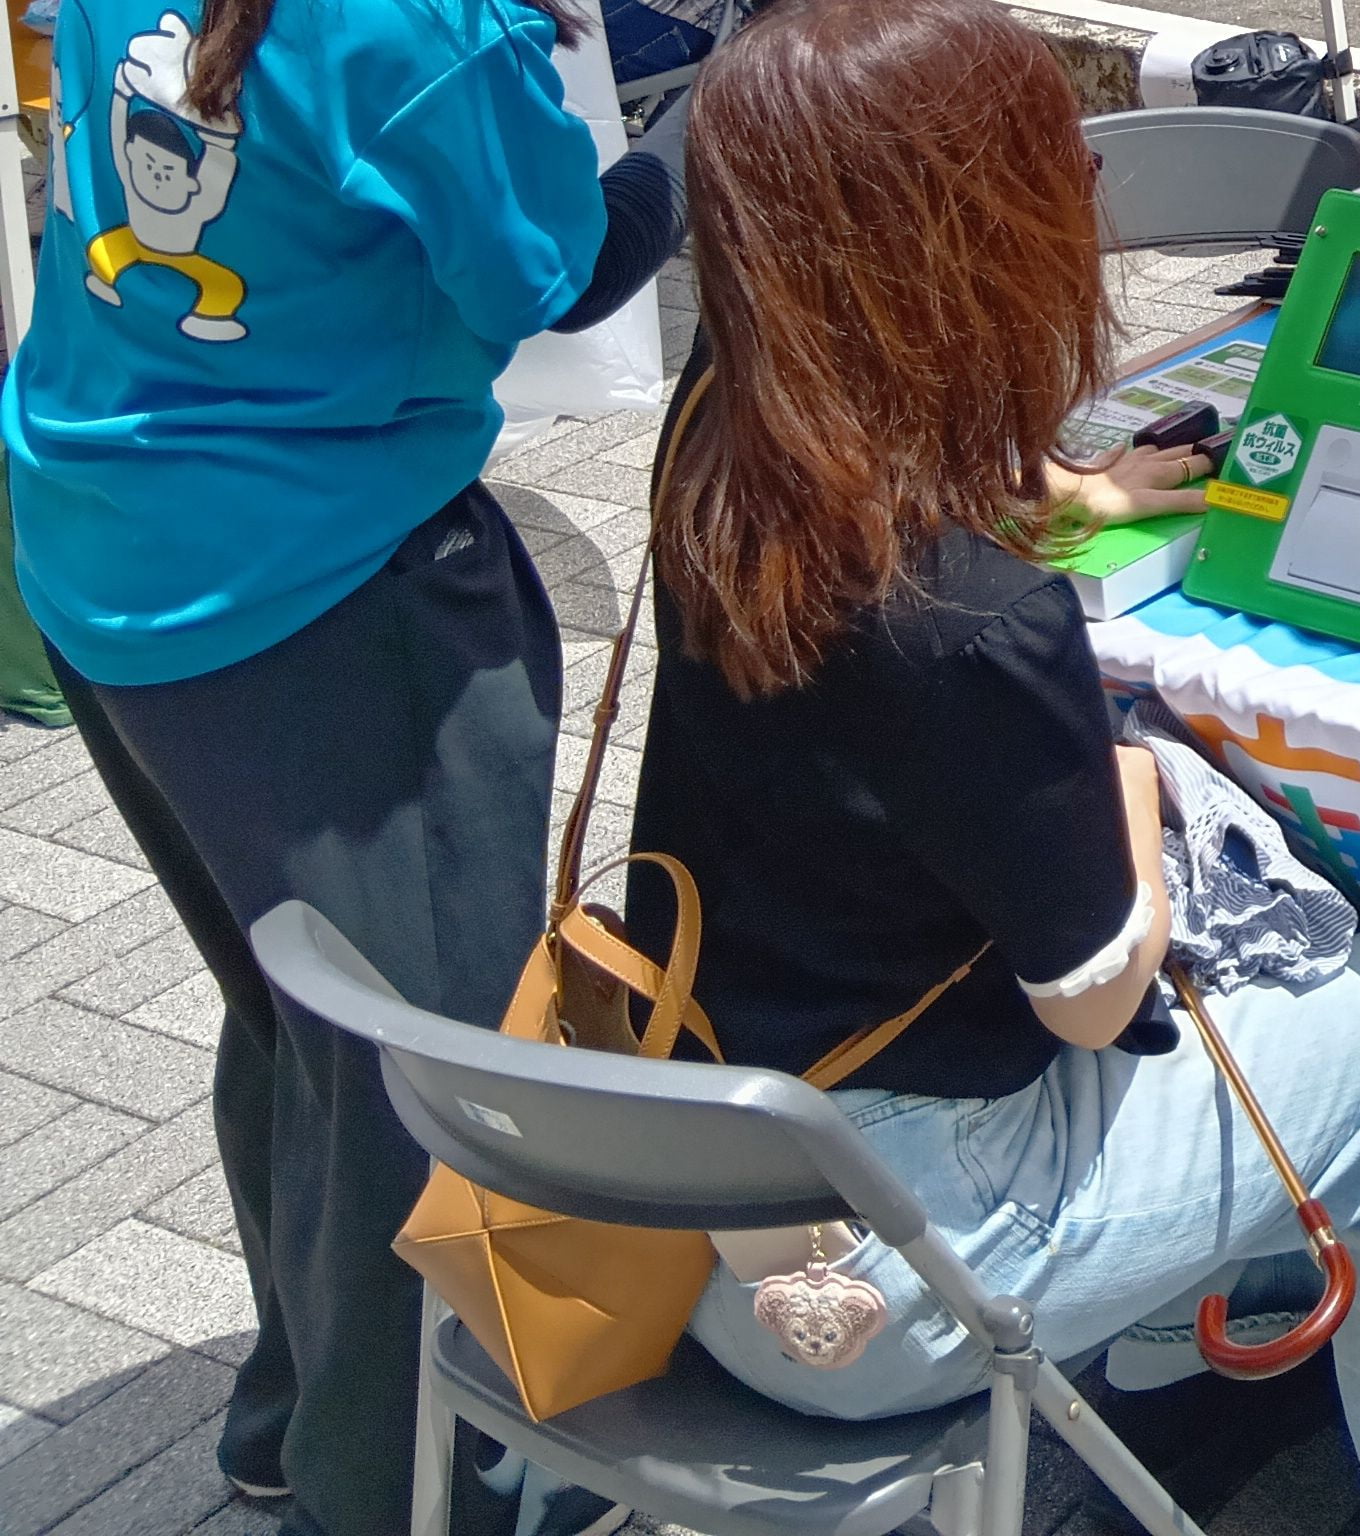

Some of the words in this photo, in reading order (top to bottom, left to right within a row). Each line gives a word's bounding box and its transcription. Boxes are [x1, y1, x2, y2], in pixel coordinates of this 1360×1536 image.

[1262, 421, 1288, 438] 抗菌
[1243, 432, 1297, 457] 抗ウィルス
